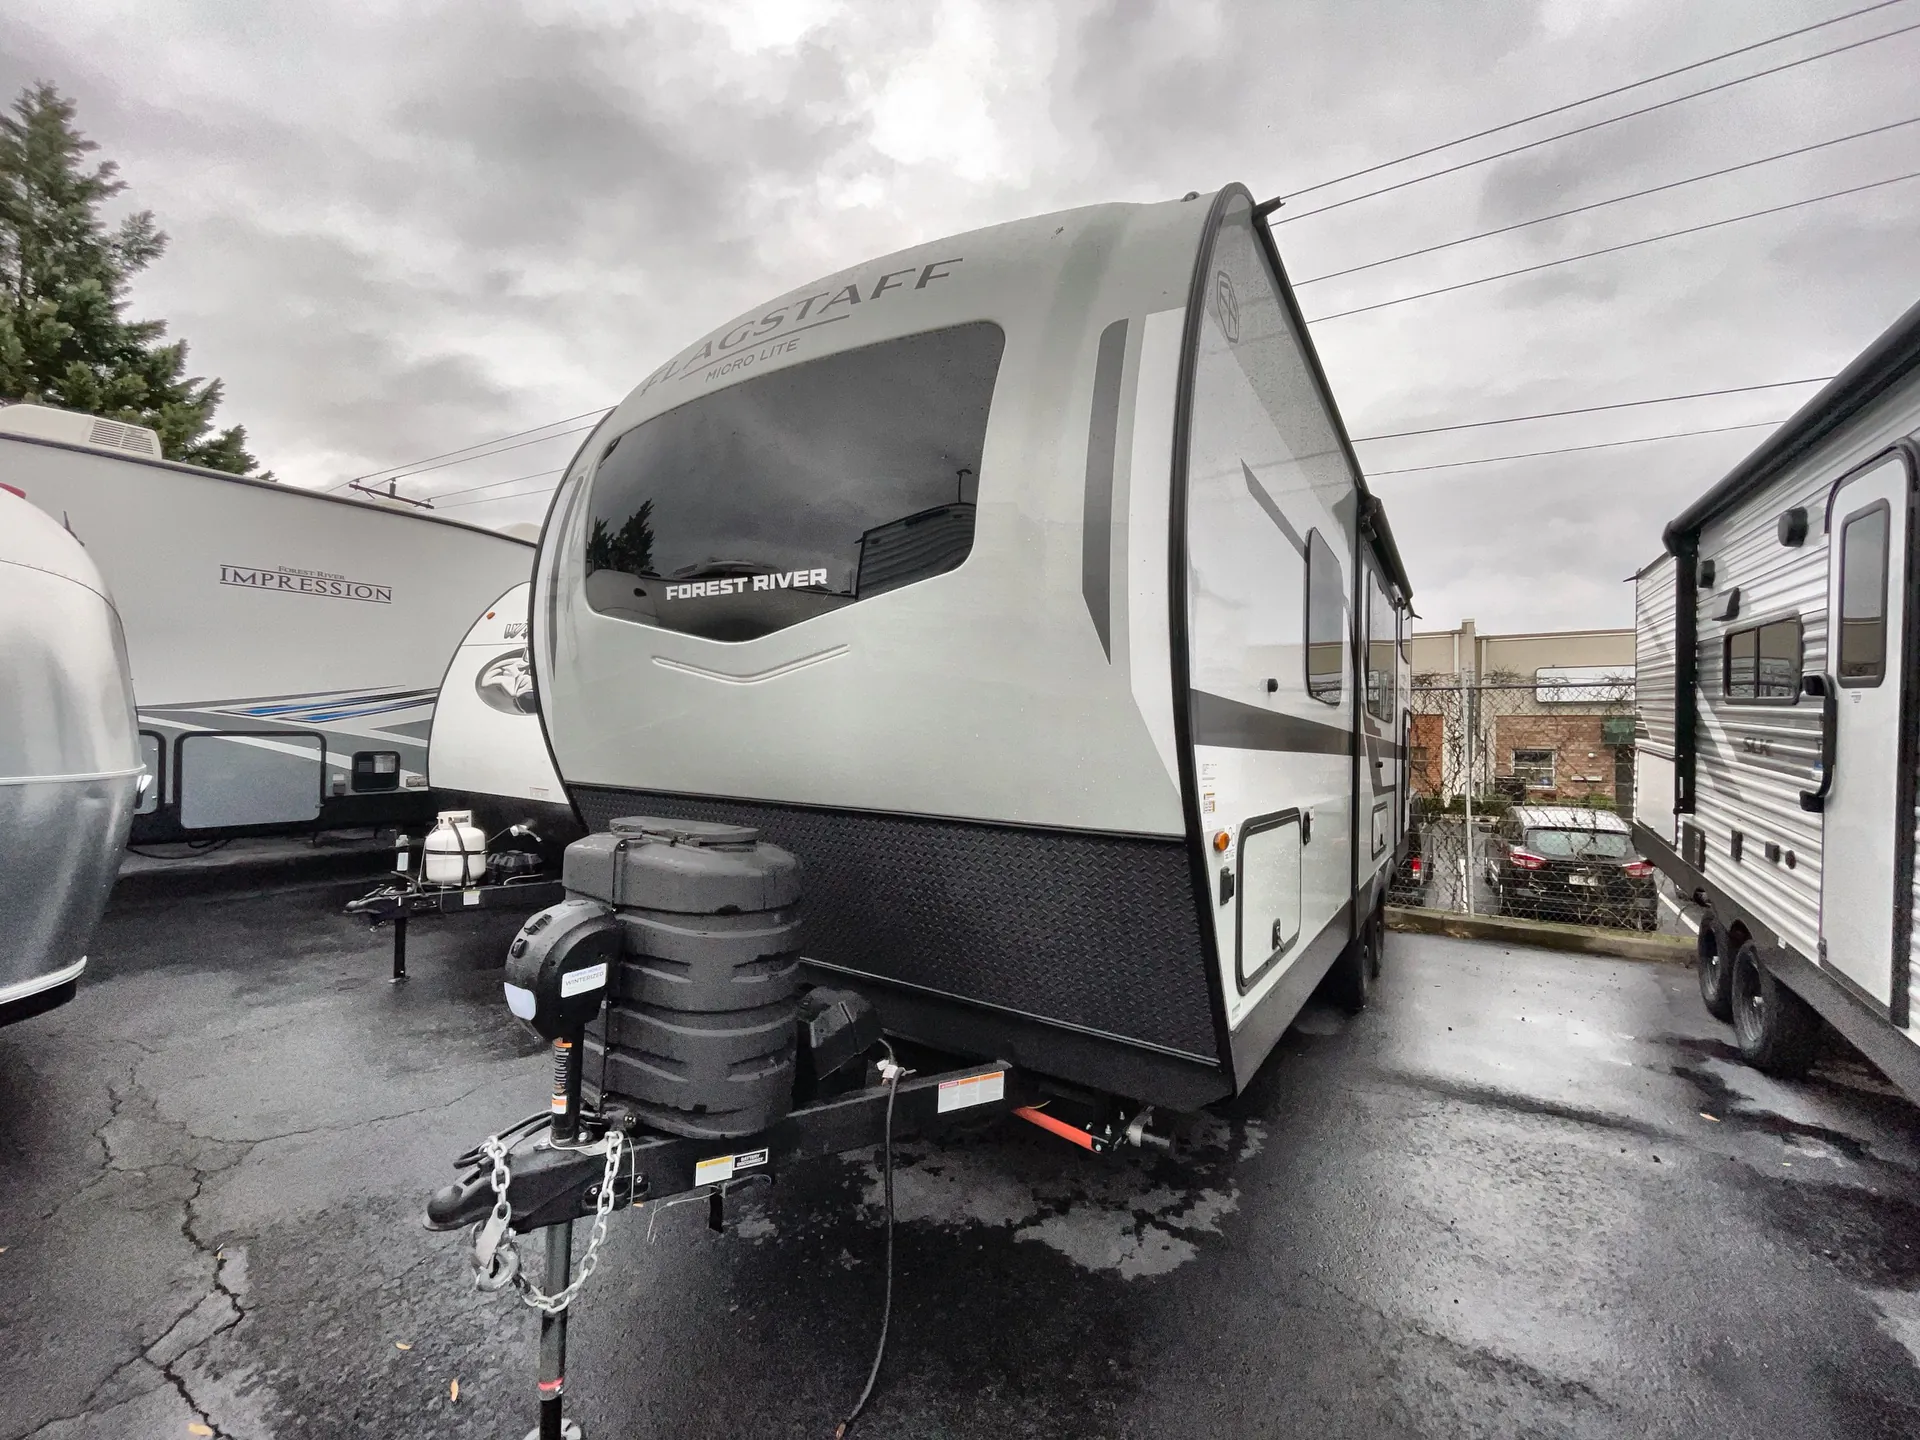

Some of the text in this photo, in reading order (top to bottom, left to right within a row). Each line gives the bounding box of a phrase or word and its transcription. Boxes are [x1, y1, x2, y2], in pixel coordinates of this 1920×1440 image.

[639, 257, 964, 397] FLAGSTAFF
[705, 337, 801, 383] MICRO LITE
[220, 567, 392, 601] IMPRESSION
[666, 568, 827, 600] FOREST RIVER
[565, 971, 603, 986] WINTERIZED
